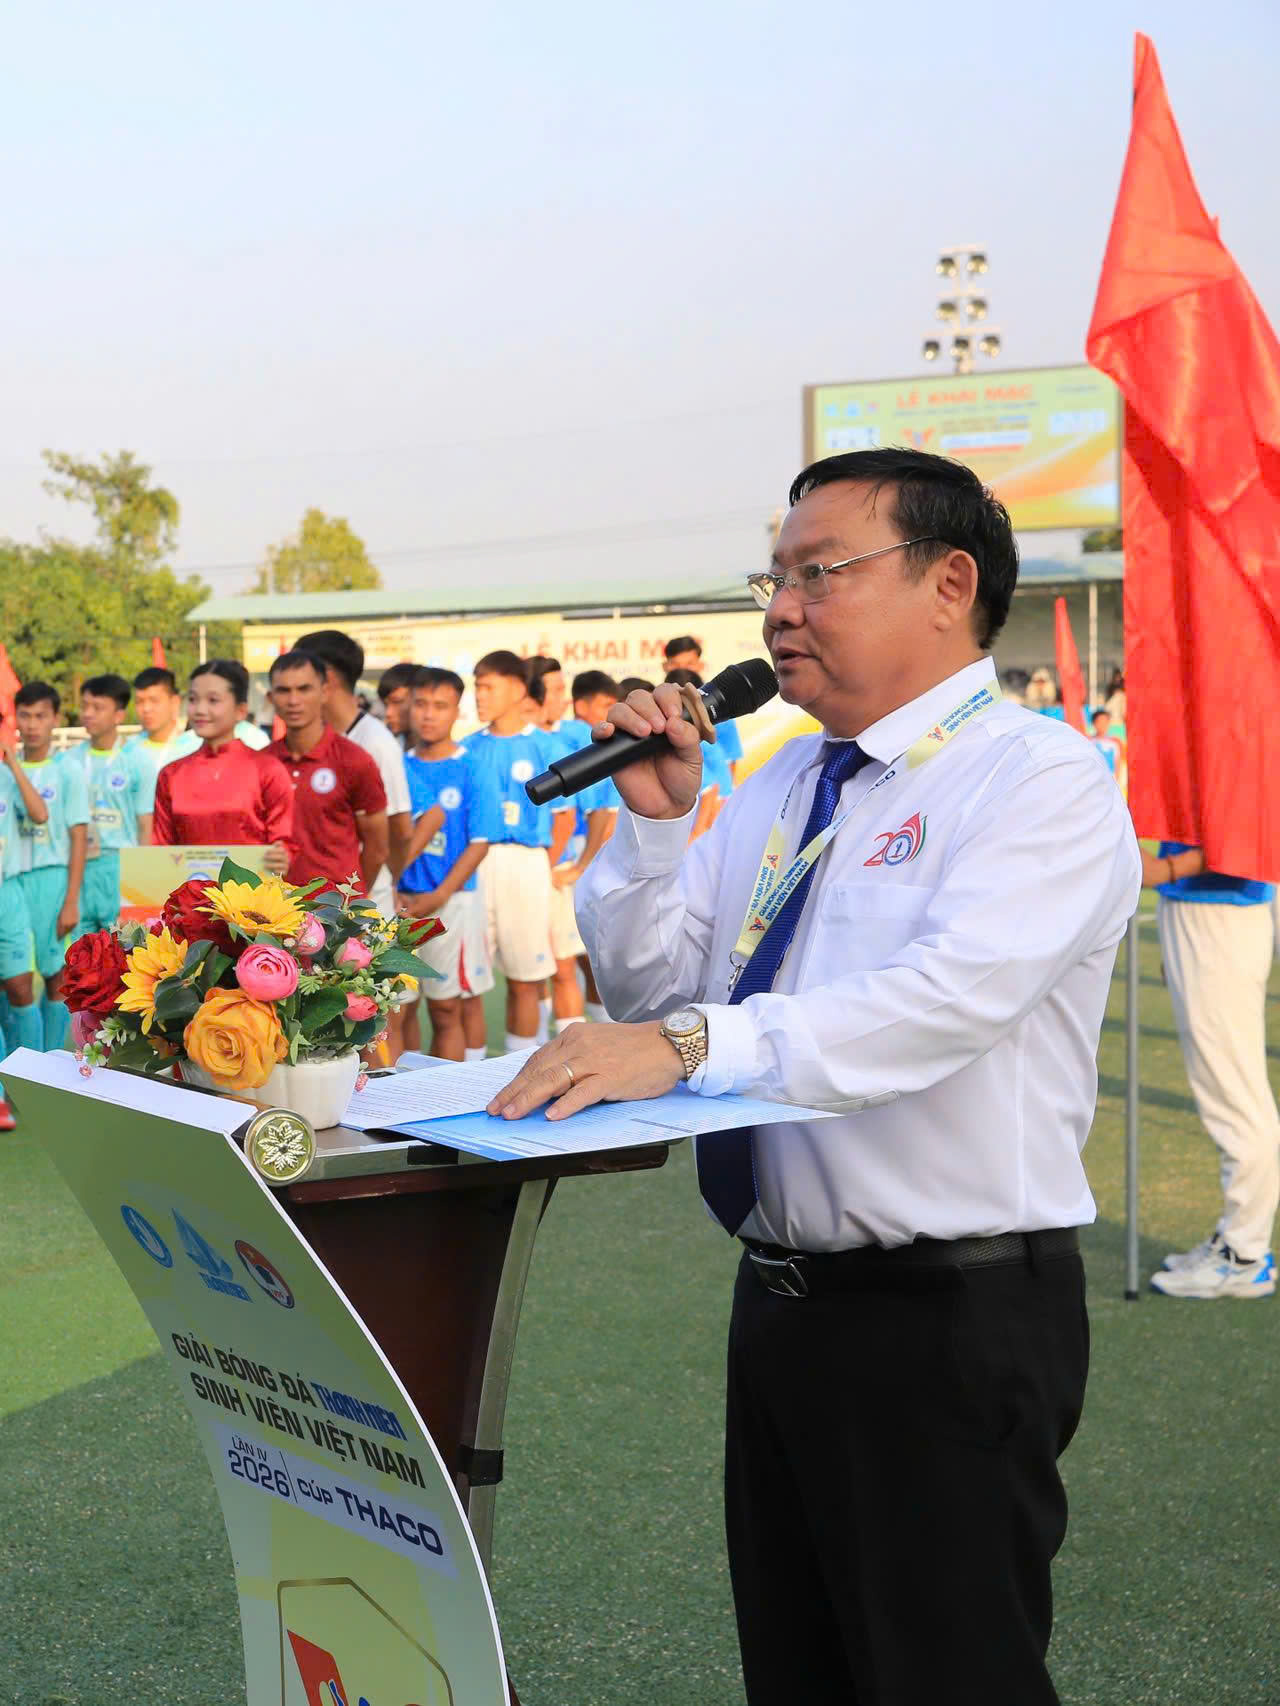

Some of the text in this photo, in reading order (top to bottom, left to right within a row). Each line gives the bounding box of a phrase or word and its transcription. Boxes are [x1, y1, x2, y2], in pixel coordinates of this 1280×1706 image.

[564, 638, 628, 662] KHAI
[795, 860, 809, 876] NAM
[171, 1331, 215, 1369] GIẢI
[214, 1347, 278, 1393] BÓNG
[278, 1371, 318, 1408] ĐÁ
[190, 1371, 426, 1489] SINH VIÊN VIỆT NAM
[256, 1446, 267, 1461] IV
[228, 1449, 443, 1556] 2026 CÚP THACO
